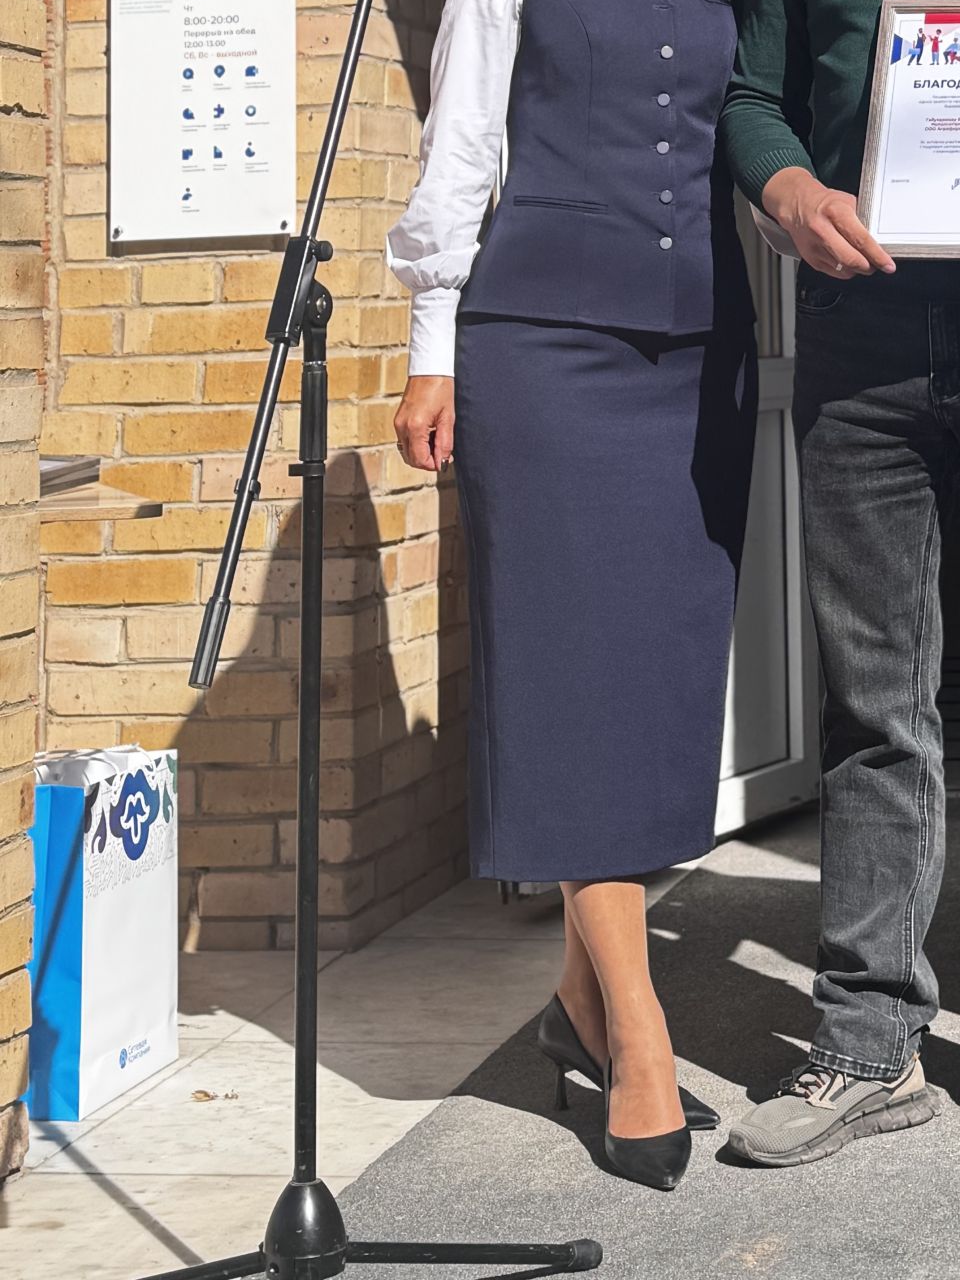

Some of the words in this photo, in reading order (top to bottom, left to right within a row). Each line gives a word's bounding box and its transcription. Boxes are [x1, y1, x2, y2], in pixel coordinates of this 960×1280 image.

[183, 15, 240, 26] 8:00-20:00
[183, 30, 222, 38] Перерыв
[216, 48, 258, 58] выходной
